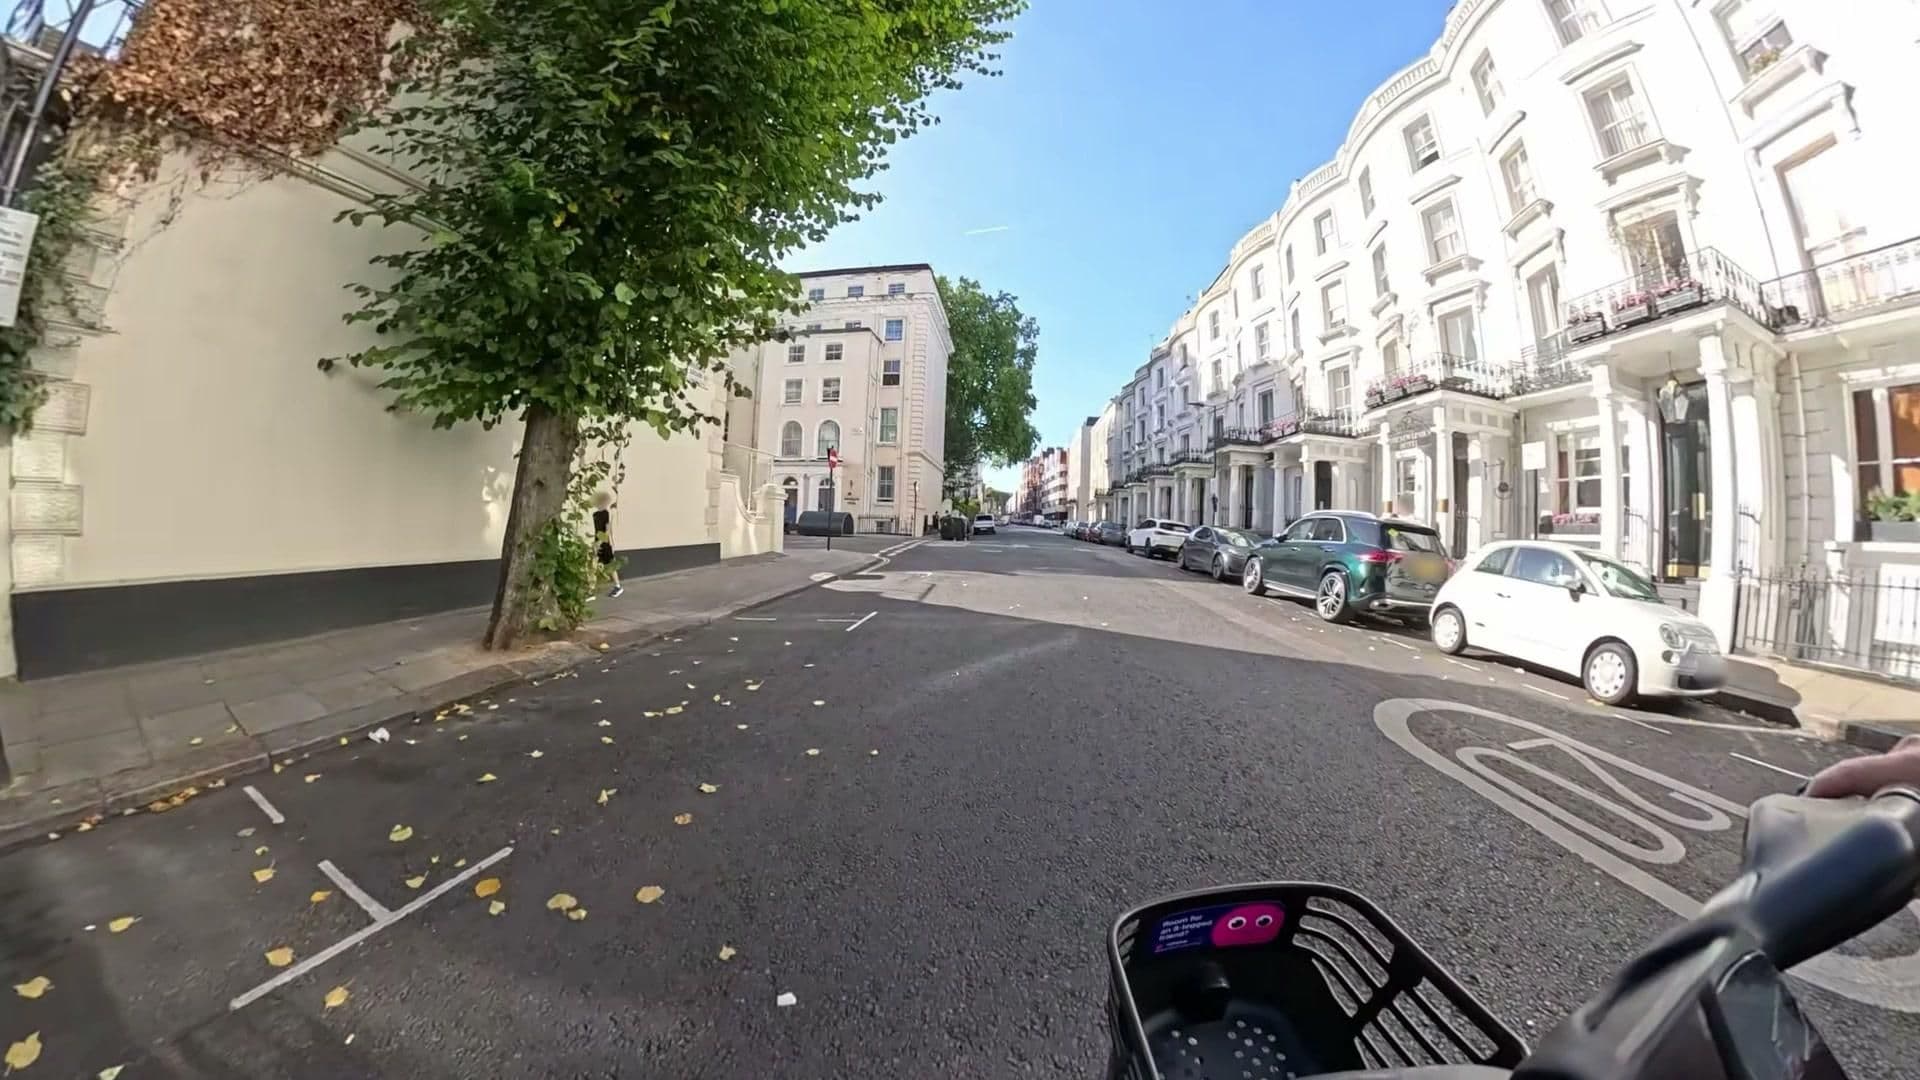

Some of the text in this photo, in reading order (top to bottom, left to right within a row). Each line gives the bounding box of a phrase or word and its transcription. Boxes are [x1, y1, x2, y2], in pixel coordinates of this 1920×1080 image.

[1455, 737, 1732, 865] 20
[1162, 914, 1203, 928] Room for
